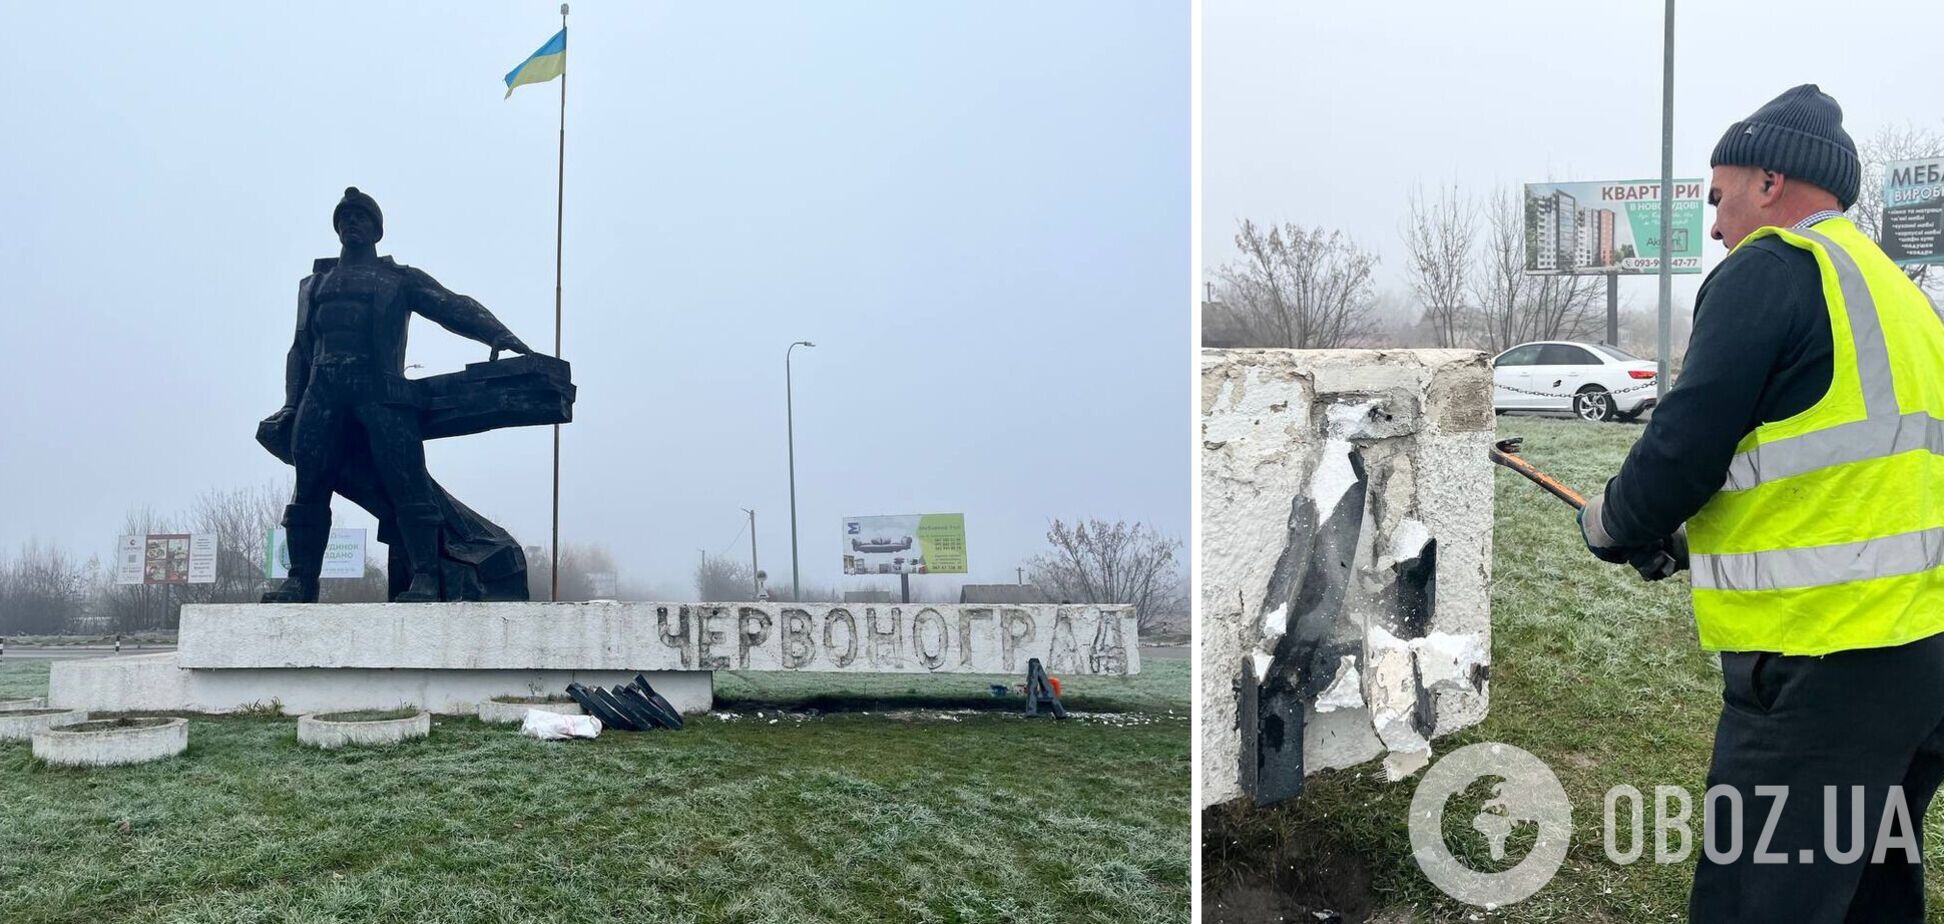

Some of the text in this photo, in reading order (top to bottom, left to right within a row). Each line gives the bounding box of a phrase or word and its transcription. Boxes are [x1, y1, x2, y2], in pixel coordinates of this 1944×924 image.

[1891, 164, 1944, 187] МЕБ
[1602, 184, 1700, 200] КВАРТРИ
[1634, 258, 1697, 267] 093-9-47-77
[656, 606, 1129, 674] ЧЕРВОНОГРАД
